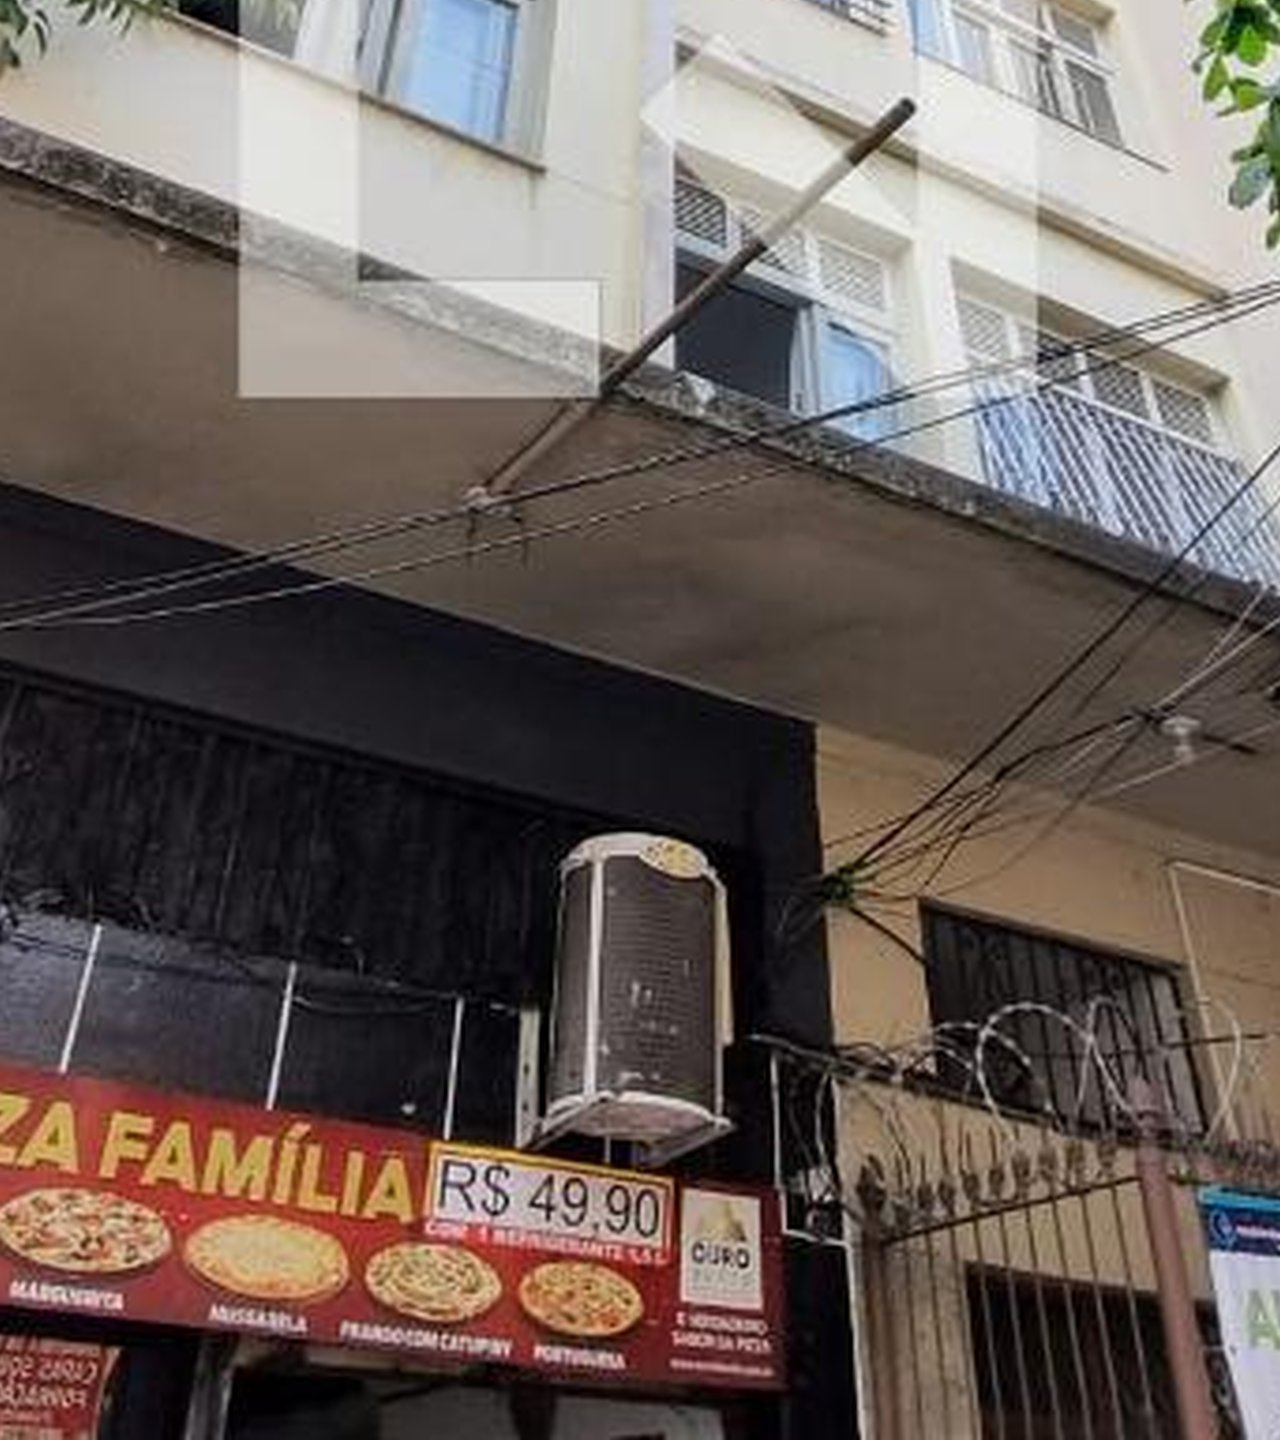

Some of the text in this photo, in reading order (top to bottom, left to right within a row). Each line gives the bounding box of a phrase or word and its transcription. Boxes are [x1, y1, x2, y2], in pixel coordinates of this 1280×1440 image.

[99, 1114, 414, 1224] FAMÍLIA
[438, 1159, 510, 1216] R$
[691, 1241, 750, 1269] OURO
